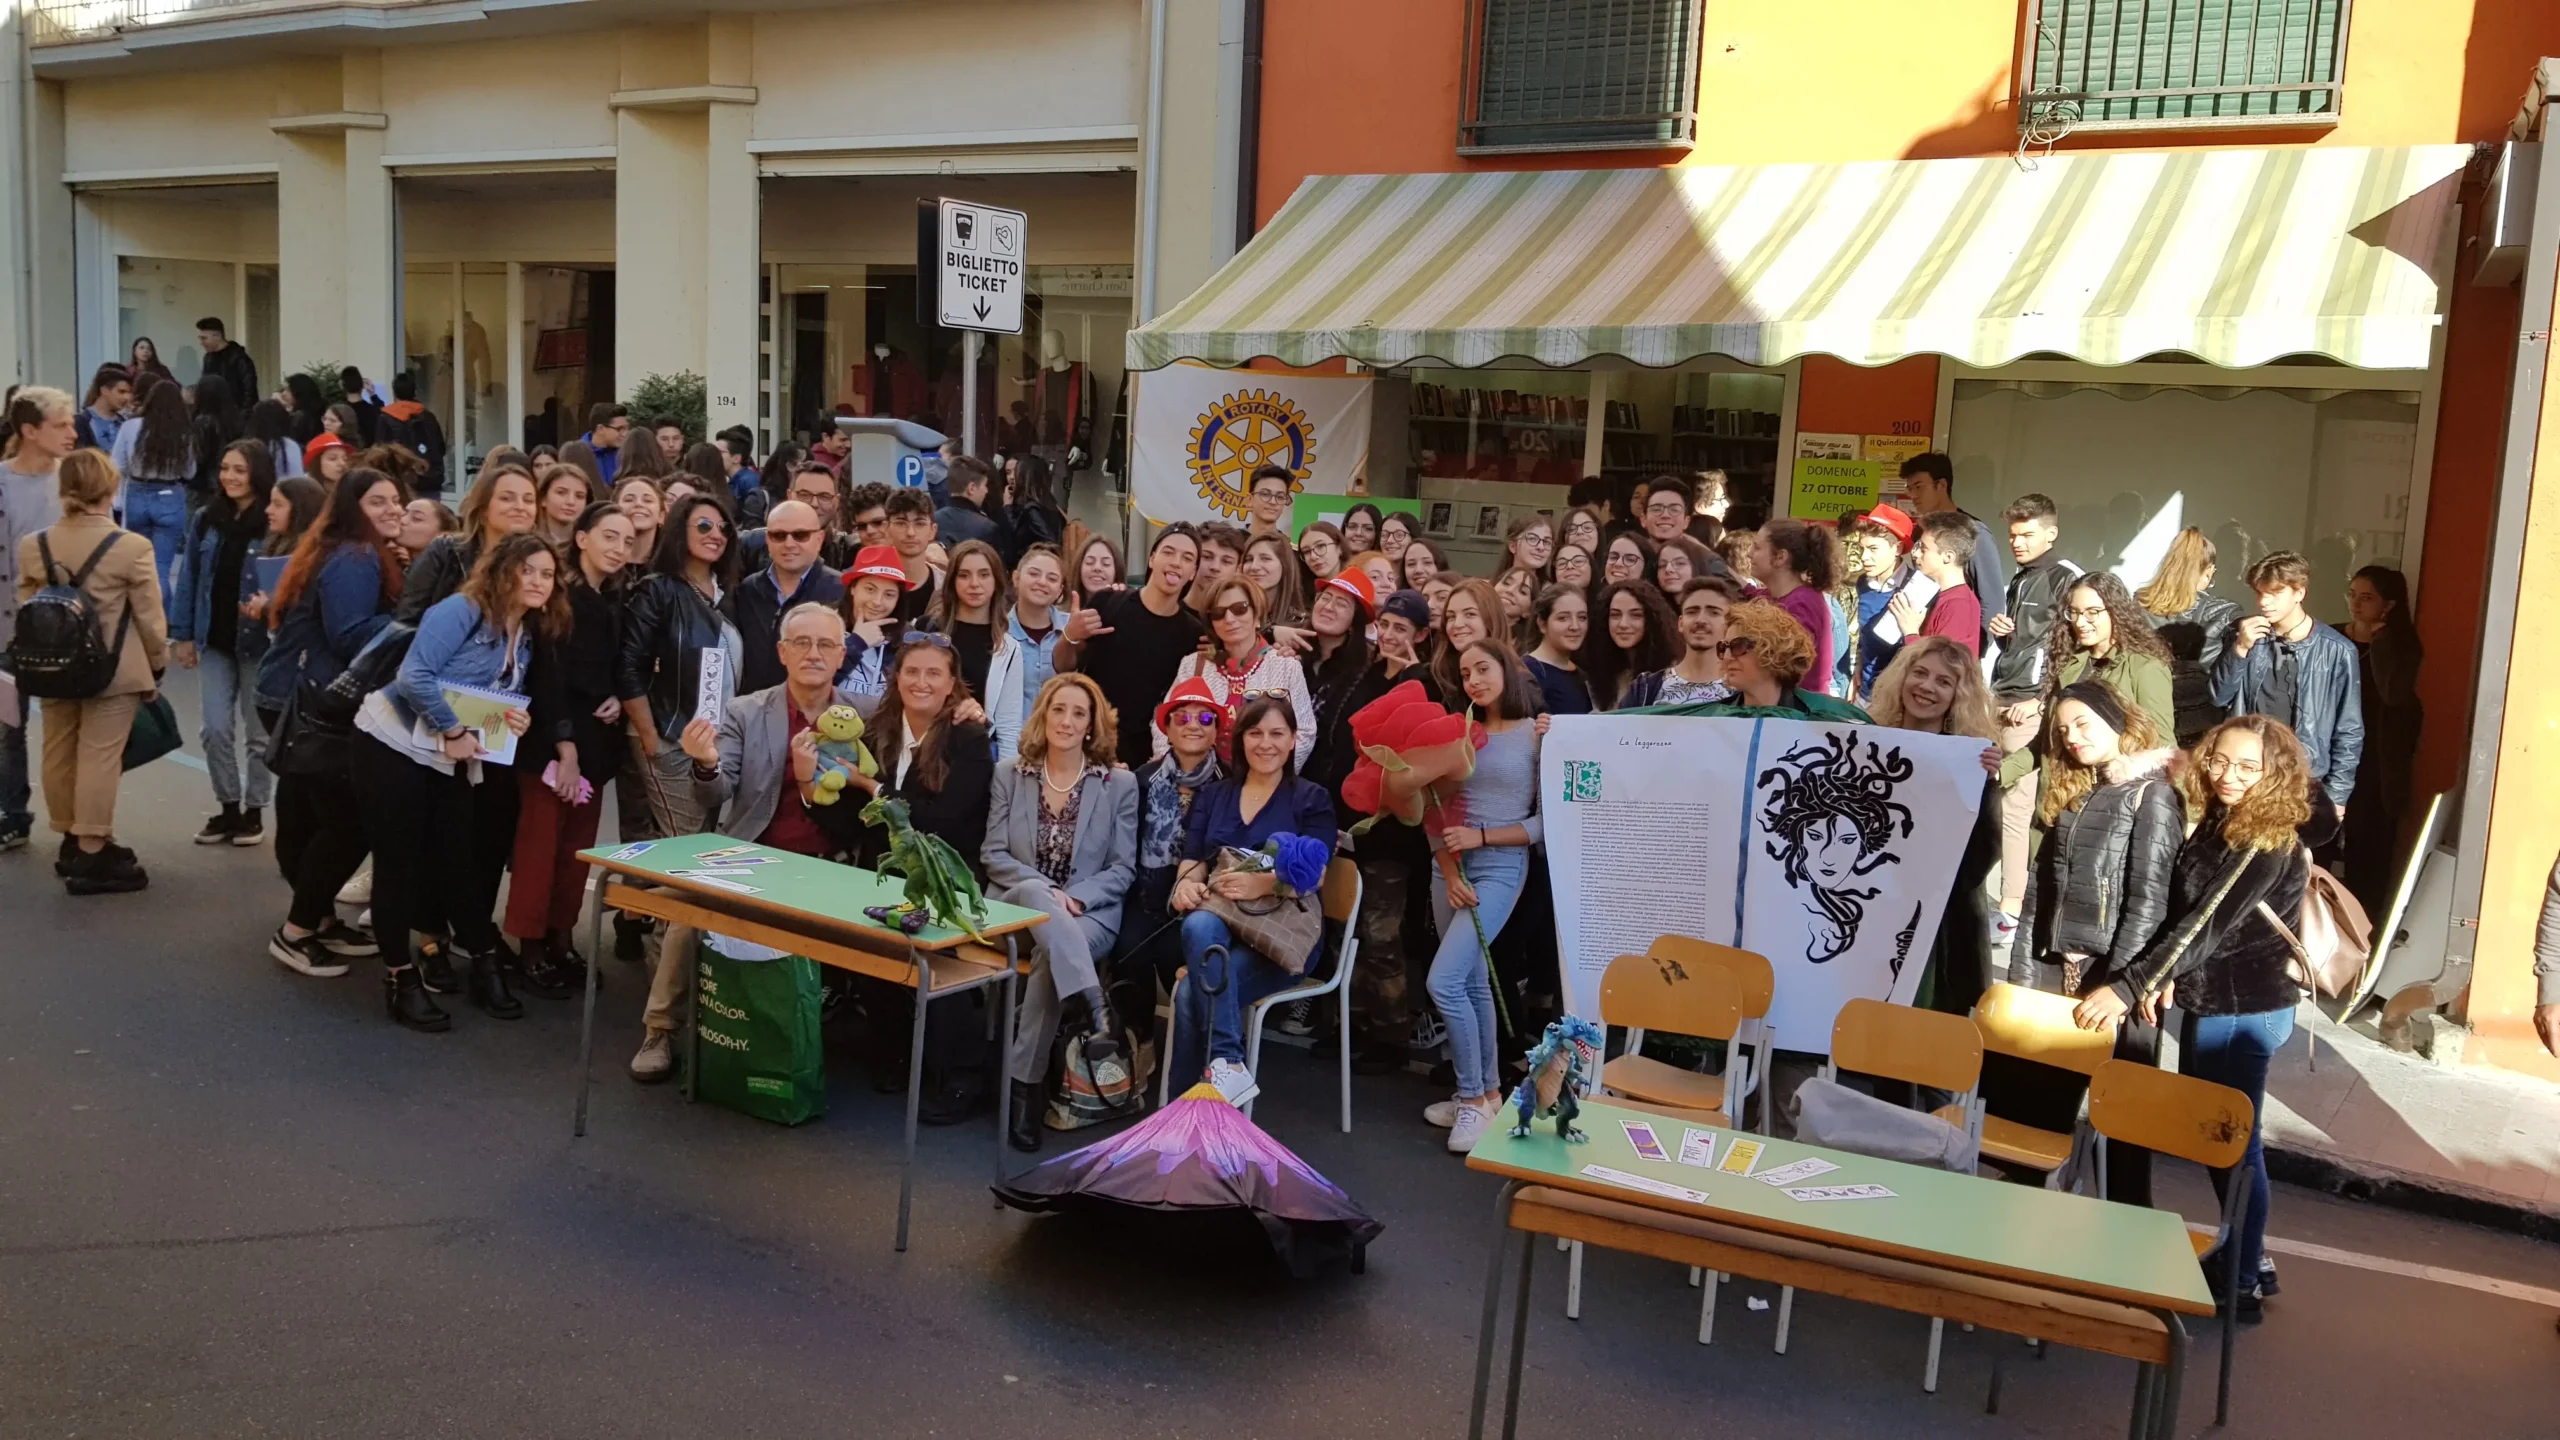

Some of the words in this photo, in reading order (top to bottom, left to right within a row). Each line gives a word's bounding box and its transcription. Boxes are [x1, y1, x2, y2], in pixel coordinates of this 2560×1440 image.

[947, 252, 1018, 276] BIGLIETTO
[958, 273, 1007, 293] TICKET
[716, 396, 737, 407] 194
[1231, 403, 1285, 422] ROTARY
[1892, 420, 1921, 435] 200
[1876, 439, 1923, 447] Quindicinale
[905, 457, 921, 486] P
[1807, 465, 1867, 478] DOMENICA
[1201, 466, 1251, 508] INTERNA
[1801, 483, 1815, 493] 27
[1817, 484, 1869, 496] OTTOBRE
[1812, 502, 1854, 513] APERTO
[698, 1024, 750, 1051] HILOSOPHY.
